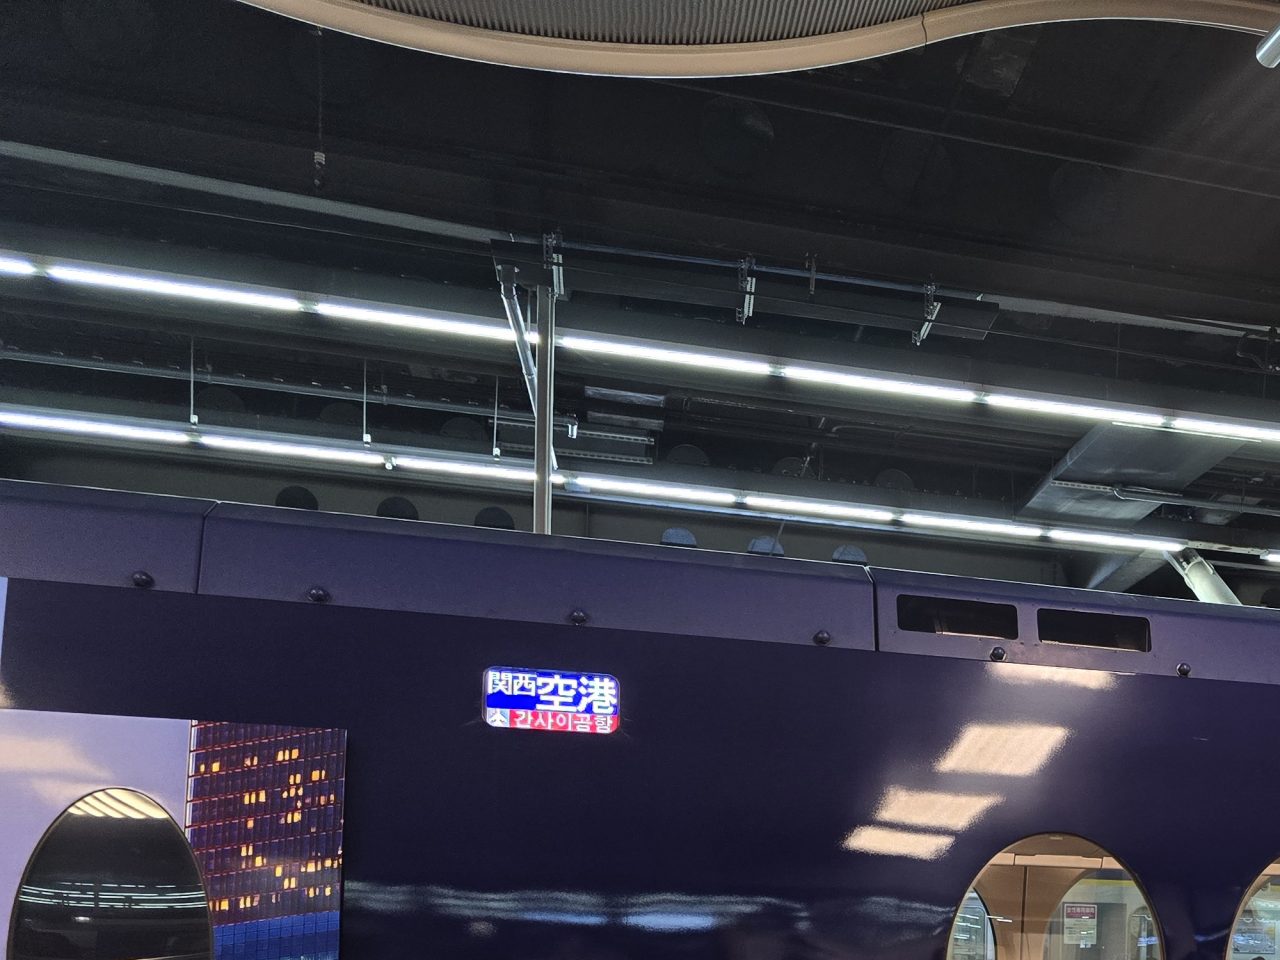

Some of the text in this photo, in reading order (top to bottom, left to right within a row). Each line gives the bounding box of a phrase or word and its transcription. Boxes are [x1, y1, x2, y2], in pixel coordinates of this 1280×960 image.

[487, 671, 616, 713] 関西空港
[514, 710, 613, 733] 간사이공항
